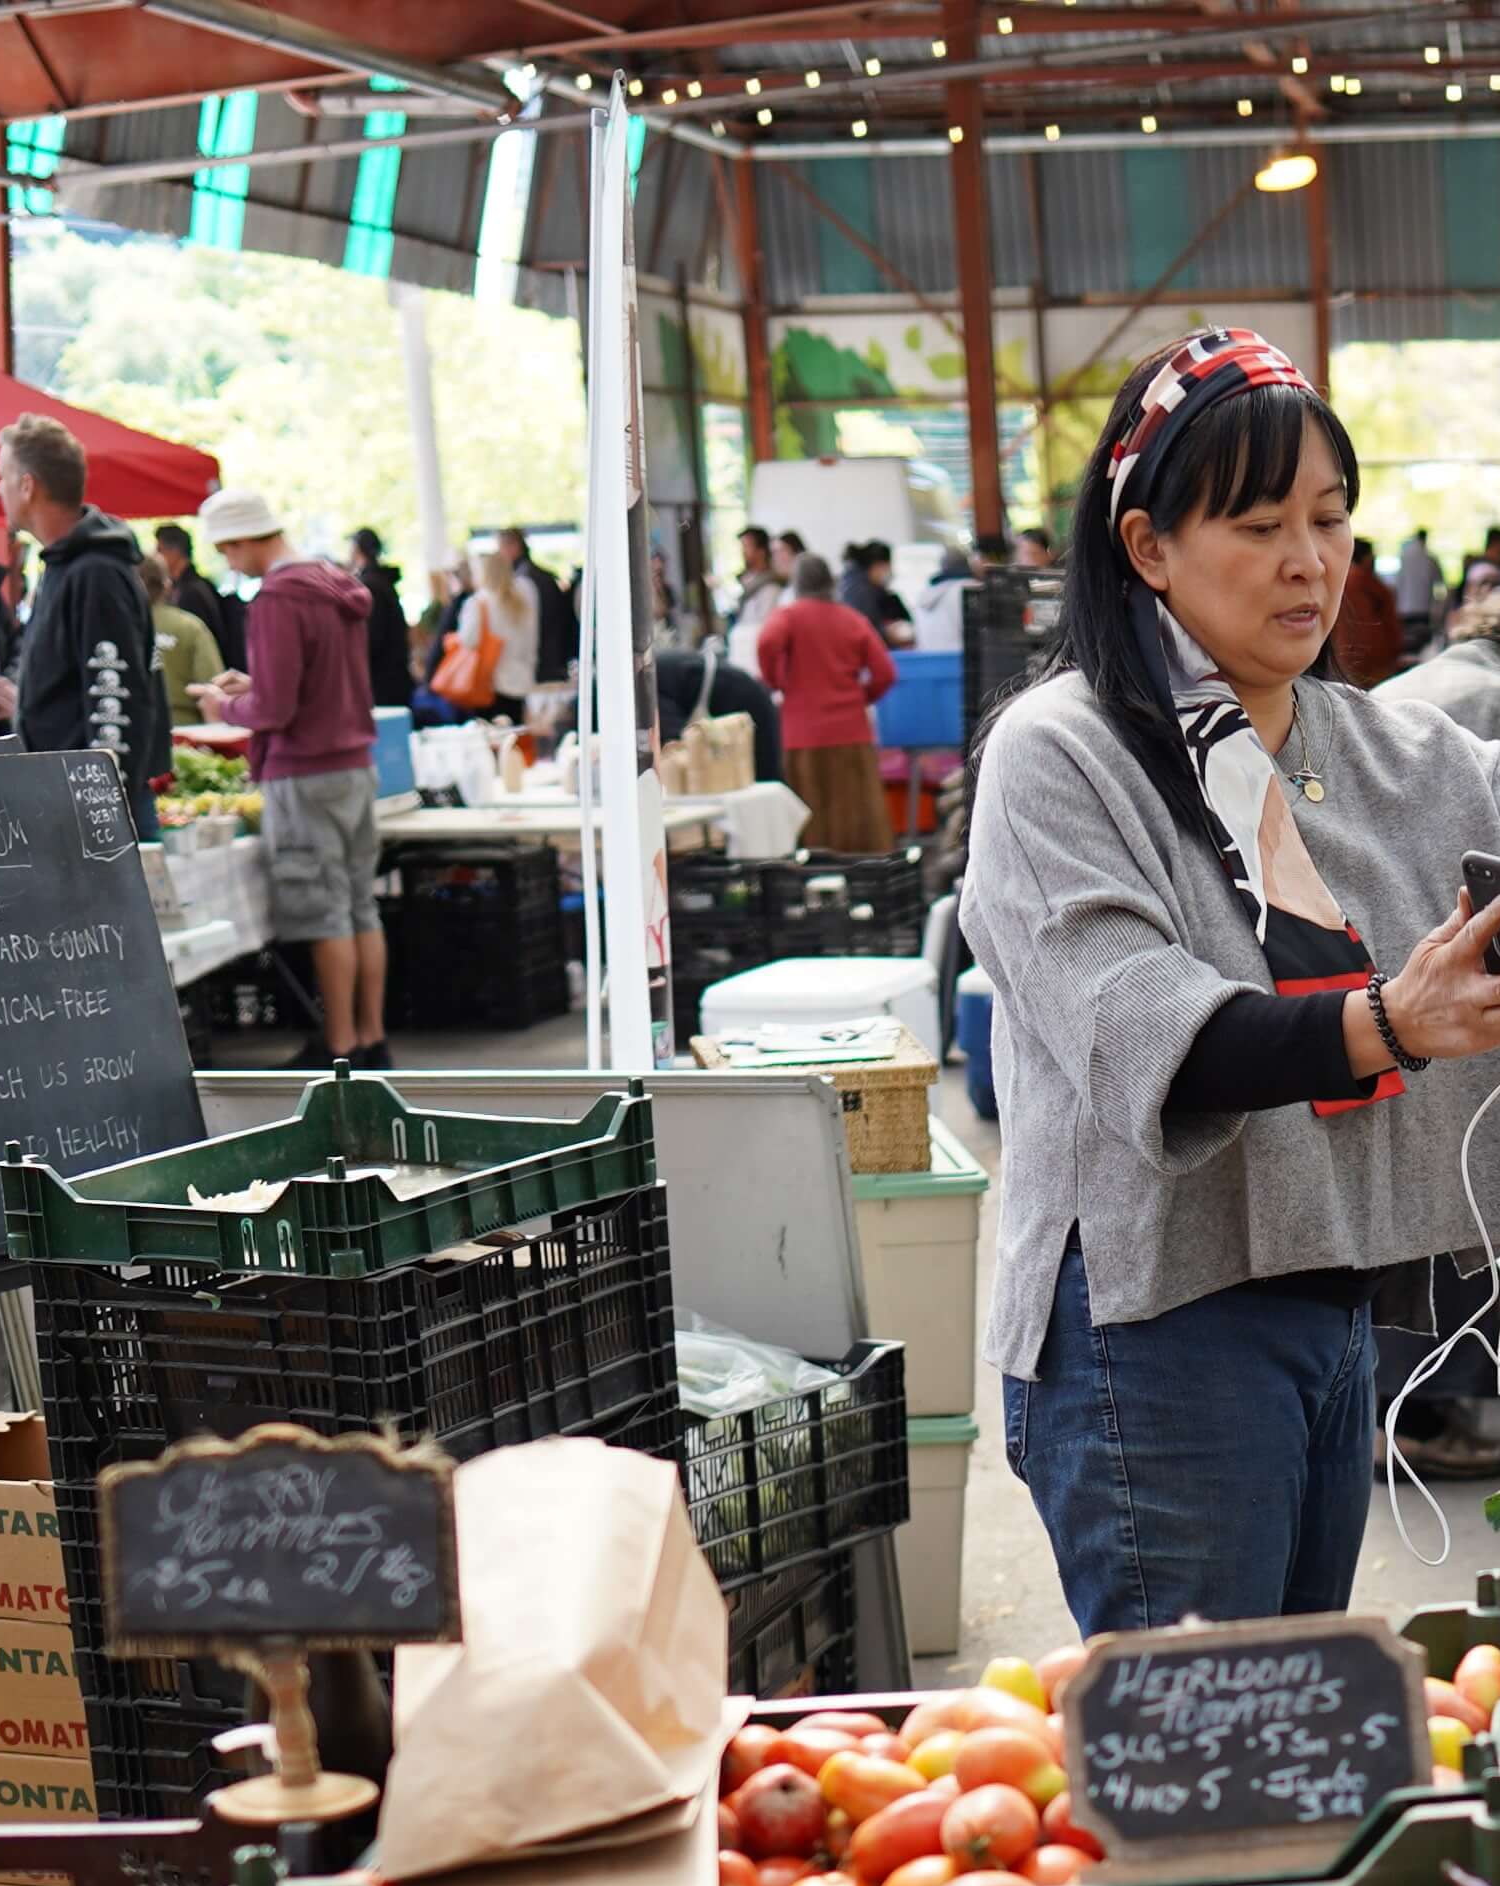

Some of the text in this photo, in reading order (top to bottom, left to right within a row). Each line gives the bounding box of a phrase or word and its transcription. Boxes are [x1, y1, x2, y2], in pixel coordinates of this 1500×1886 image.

[76, 764, 111, 785] CASH
[89, 807, 118, 824] DEBIT
[96, 828, 115, 844] CC
[50, 924, 125, 960] COUNTY
[39, 1062, 68, 1089] US
[84, 1050, 136, 1085] GROW
[57, 1115, 141, 1160] HEALTHY
[1109, 1649, 1323, 1708] HEIRLOOM
